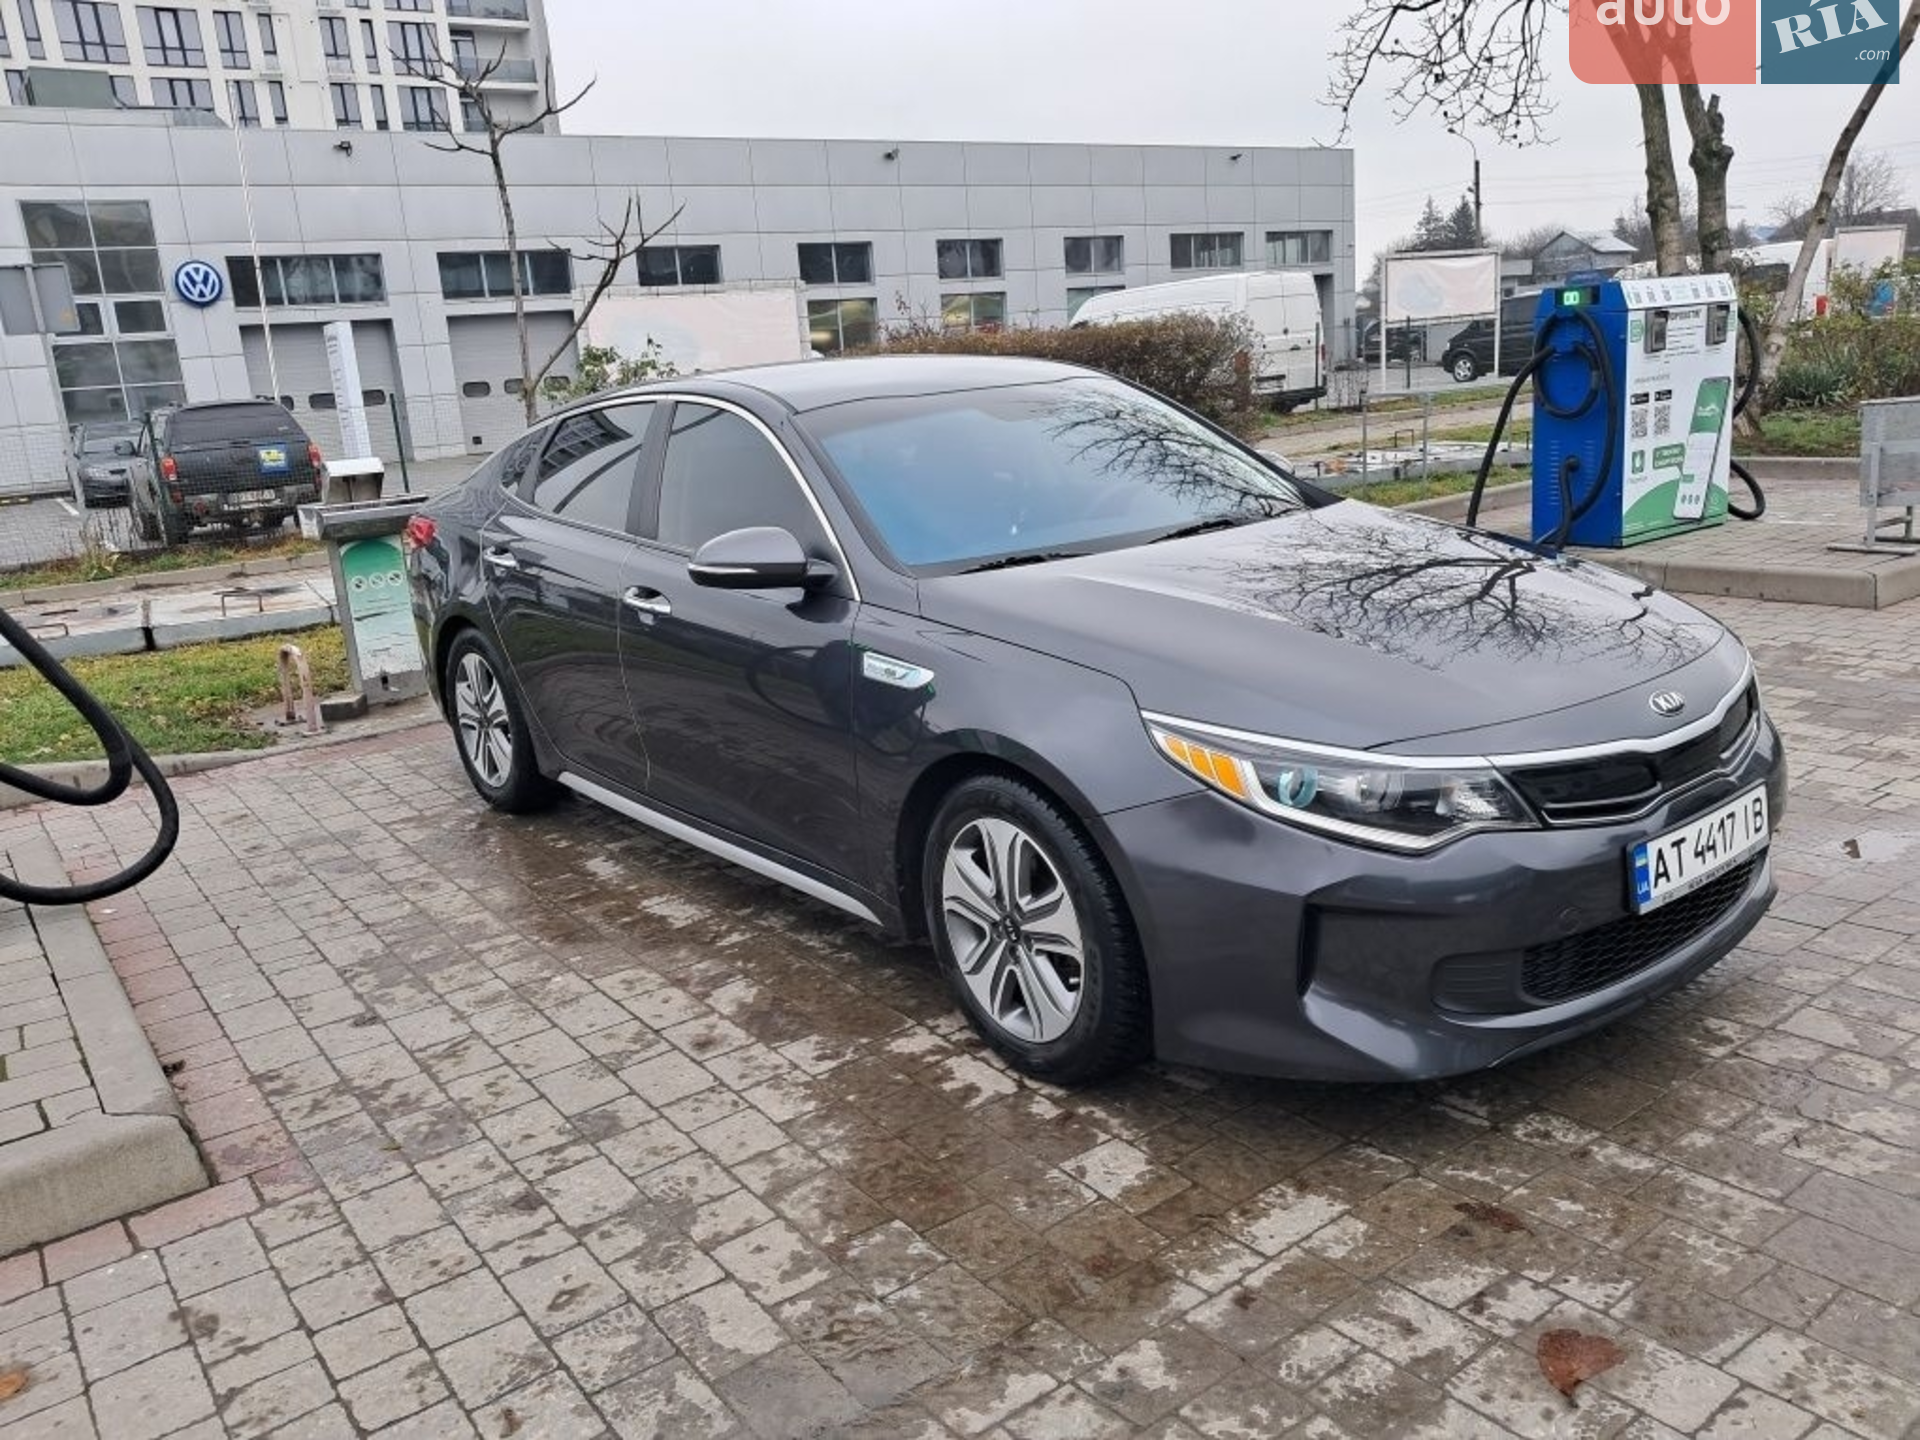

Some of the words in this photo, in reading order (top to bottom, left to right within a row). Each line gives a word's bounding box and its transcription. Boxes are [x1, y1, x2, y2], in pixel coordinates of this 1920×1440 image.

[1653, 838, 1687, 888] AT
[1693, 811, 1736, 865] 4417
[1743, 796, 1765, 840] IB
